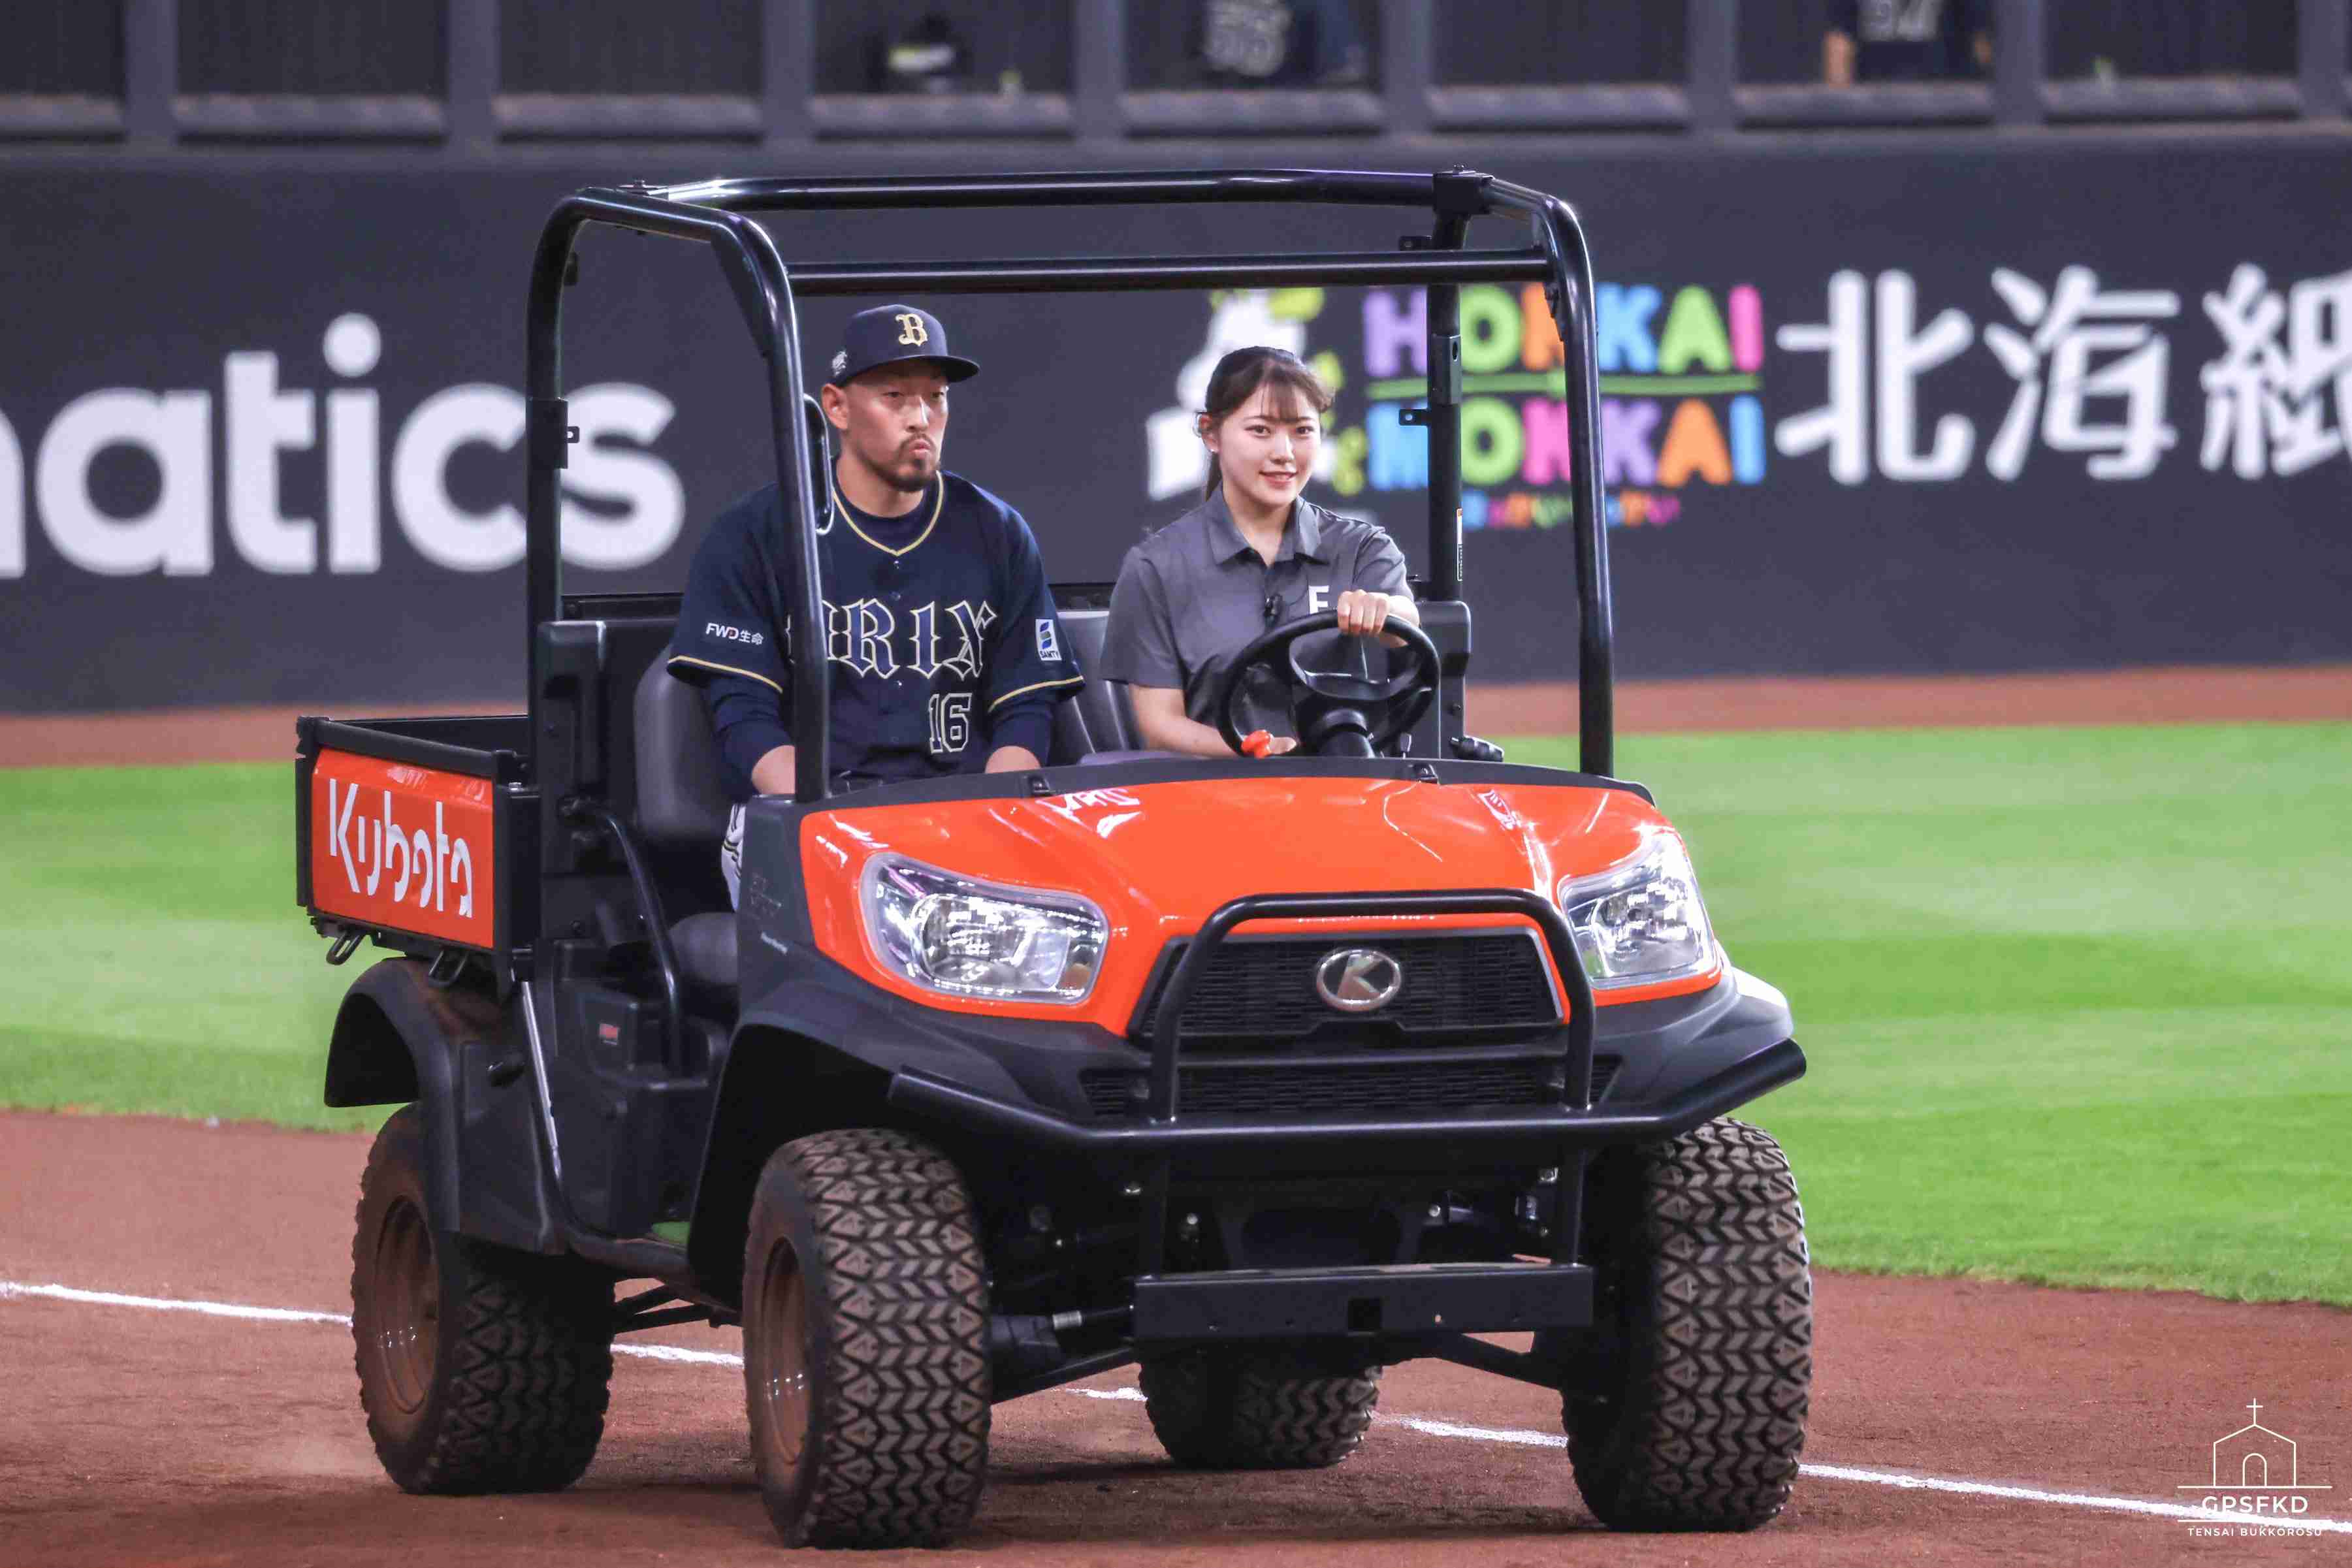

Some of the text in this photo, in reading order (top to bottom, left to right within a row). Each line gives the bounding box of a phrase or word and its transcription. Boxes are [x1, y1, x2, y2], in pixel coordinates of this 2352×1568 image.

[895, 313, 928, 347] B
[0, 312, 686, 579] atics
[1308, 584, 1330, 615] F
[705, 622, 764, 646] FWD生命
[928, 692, 972, 754] 16
[329, 777, 474, 919] Kubota
